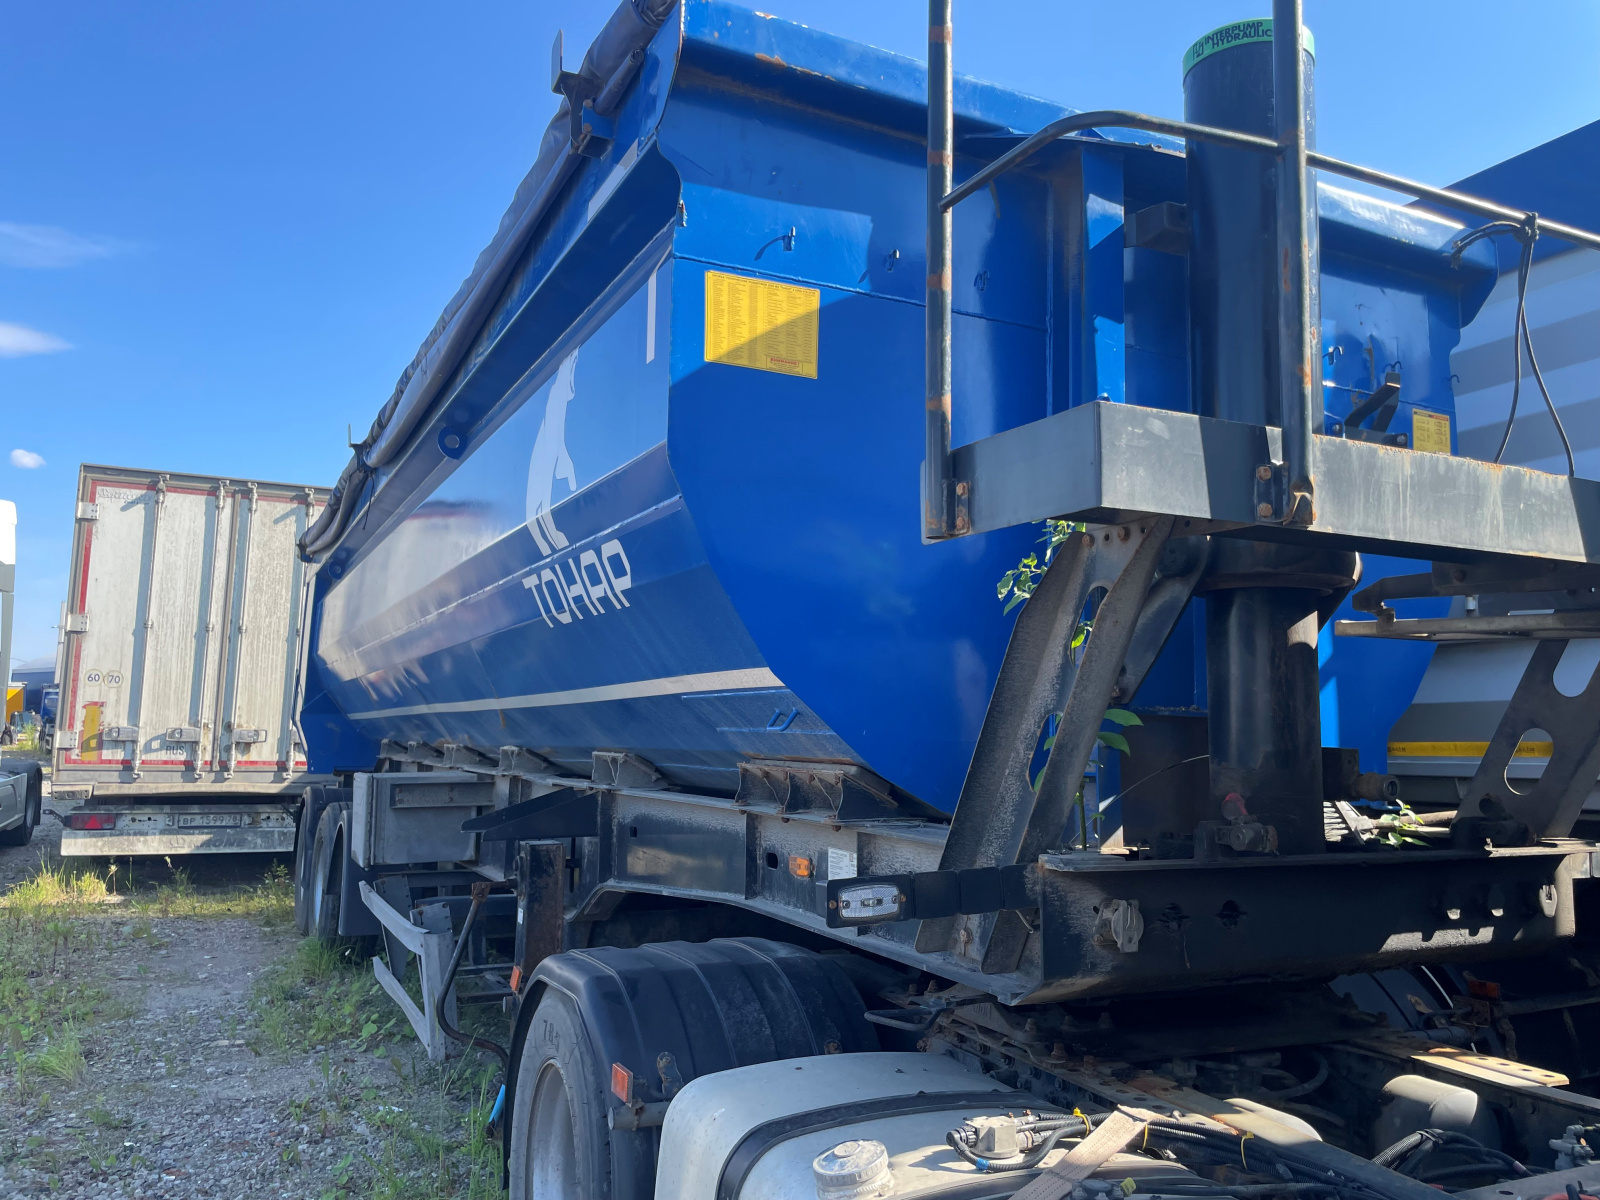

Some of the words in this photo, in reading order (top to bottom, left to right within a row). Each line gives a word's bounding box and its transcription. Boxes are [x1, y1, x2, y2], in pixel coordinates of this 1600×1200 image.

[1204, 22, 1263, 45] INTERPUMP
[87, 673, 101, 683] 60
[108, 674, 121, 684] 70
[165, 745, 185, 756] RUS
[199, 815, 225, 826] 1599
